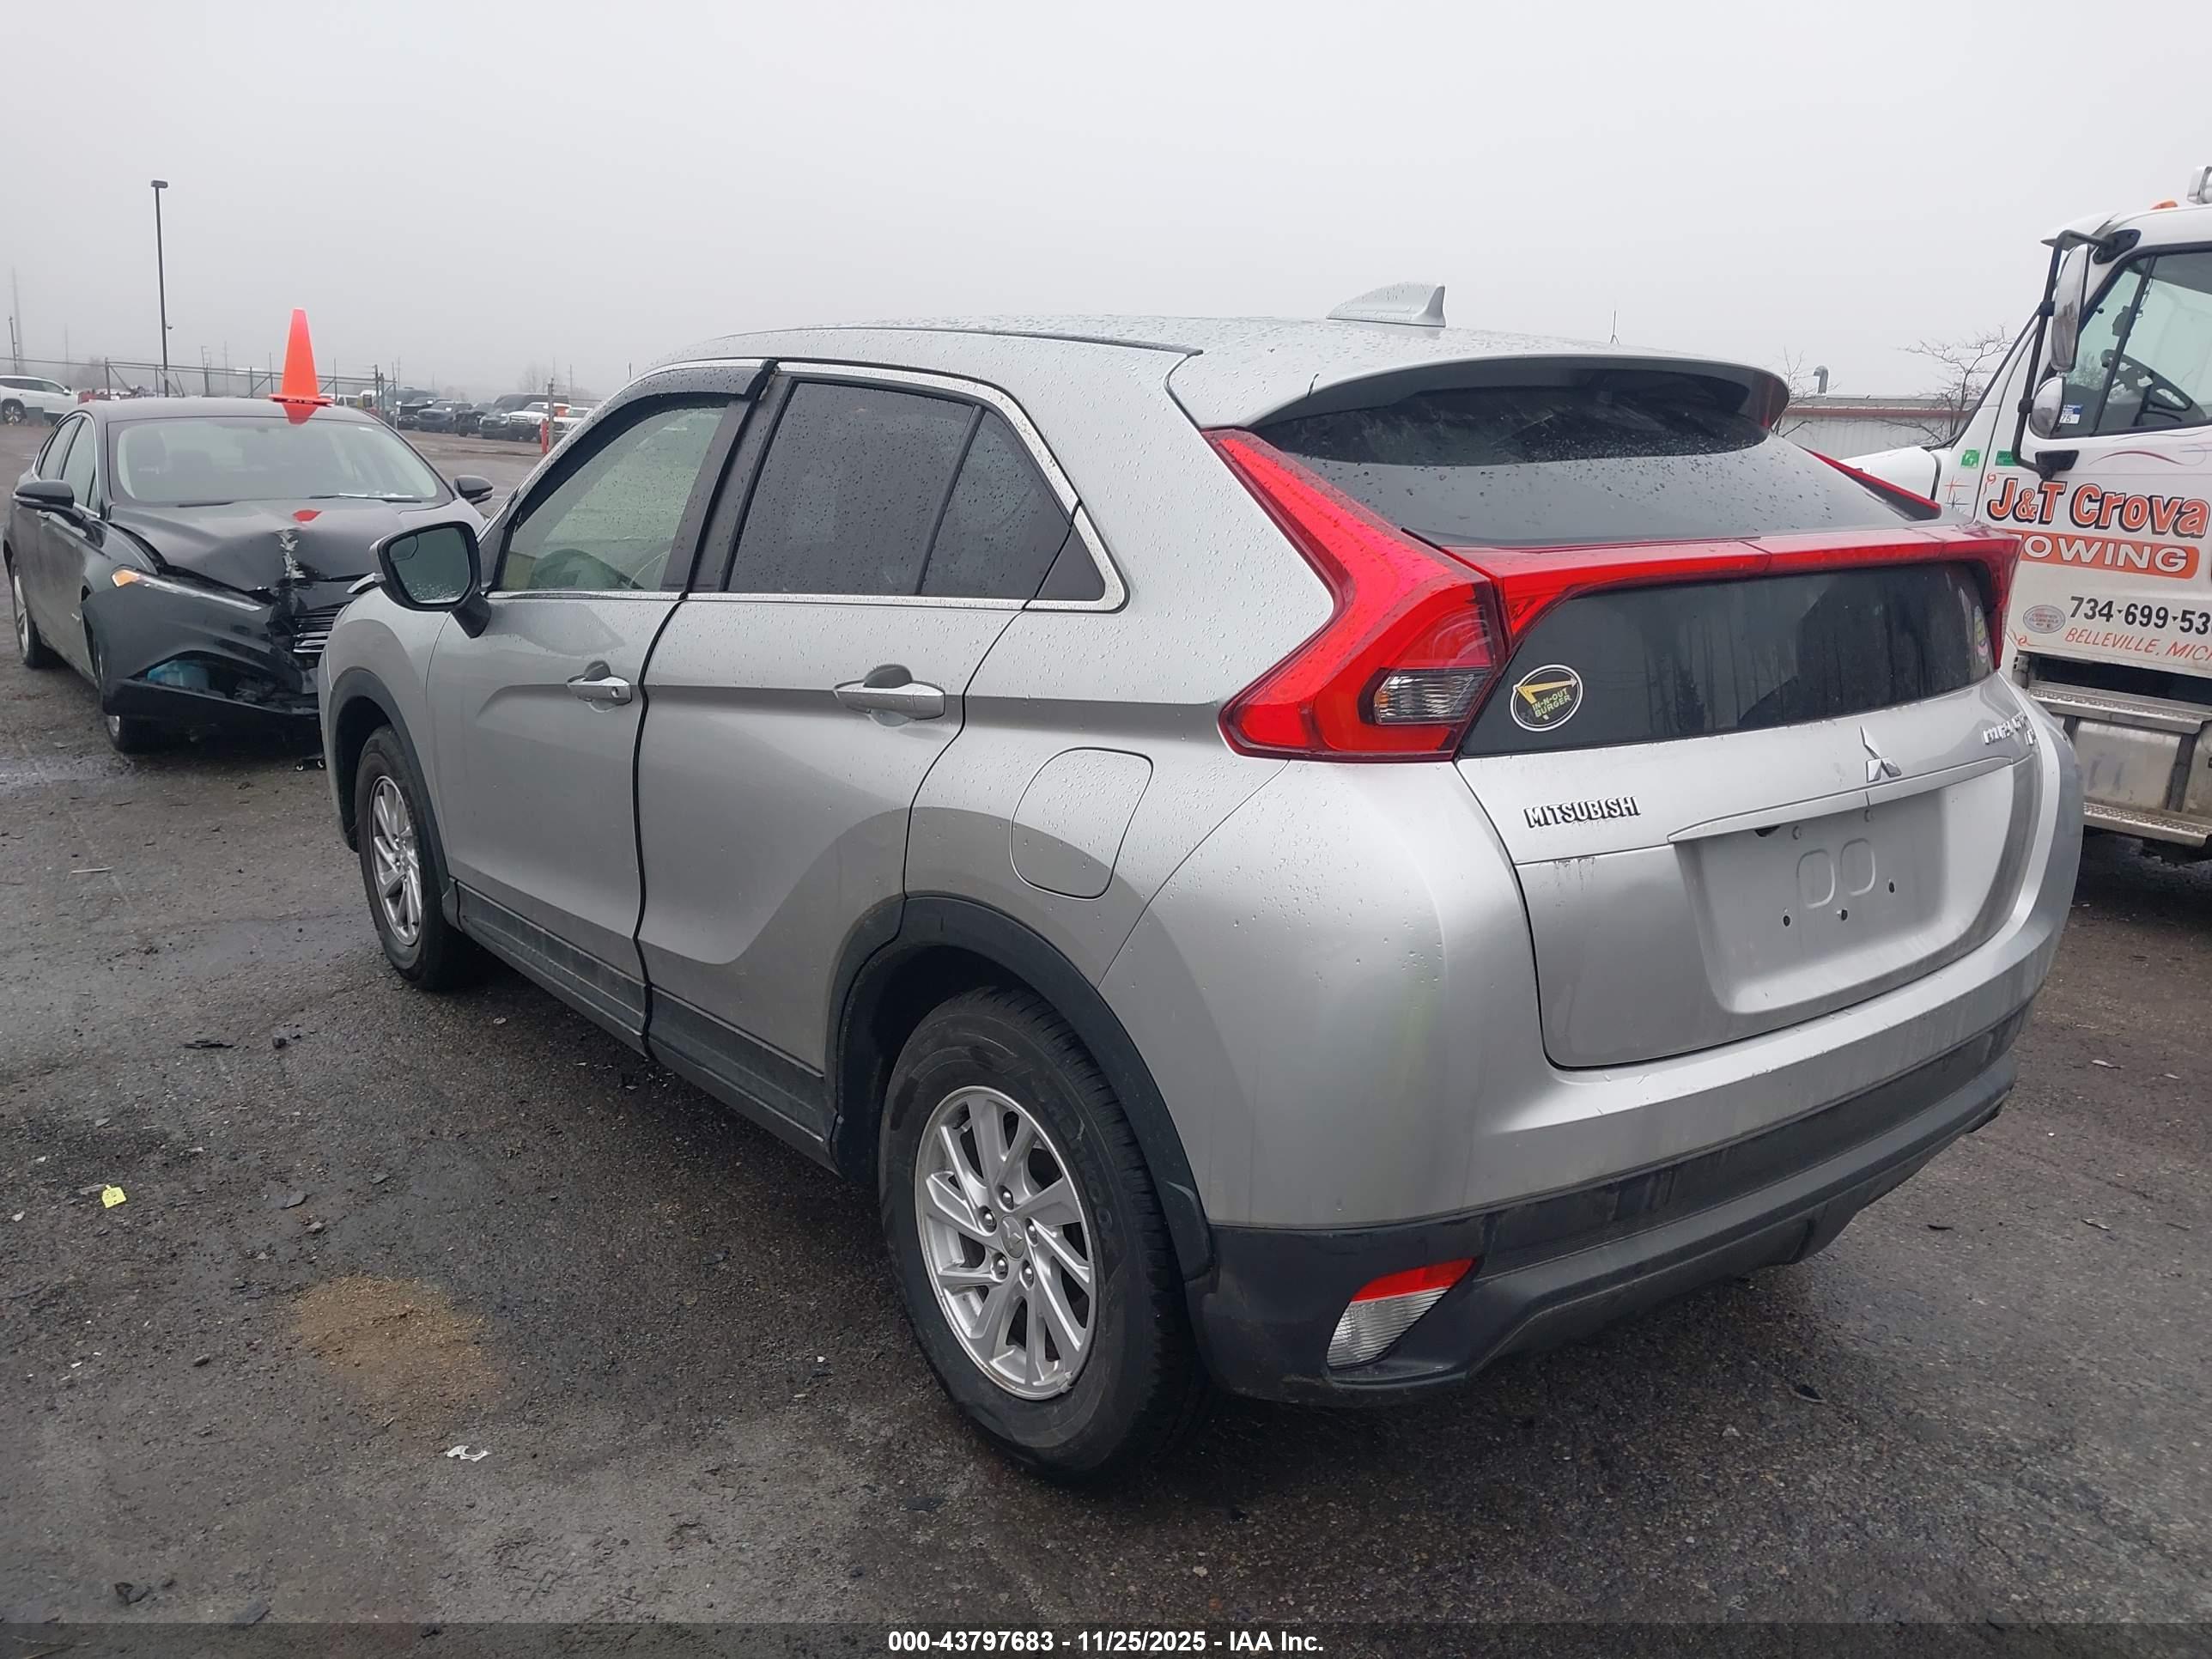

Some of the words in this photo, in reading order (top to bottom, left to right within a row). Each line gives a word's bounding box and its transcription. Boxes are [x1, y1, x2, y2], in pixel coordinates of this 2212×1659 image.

[1986, 477, 2068, 525] J&T
[2069, 483, 2211, 538] Crova
[2070, 596, 2212, 635] 734-699-53
[2064, 627, 2160, 656] BELLEVILLE,
[2165, 641, 2212, 661] MIC
[1534, 695, 1573, 718] BURGER
[1523, 796, 1642, 829] MITSUBISHI
